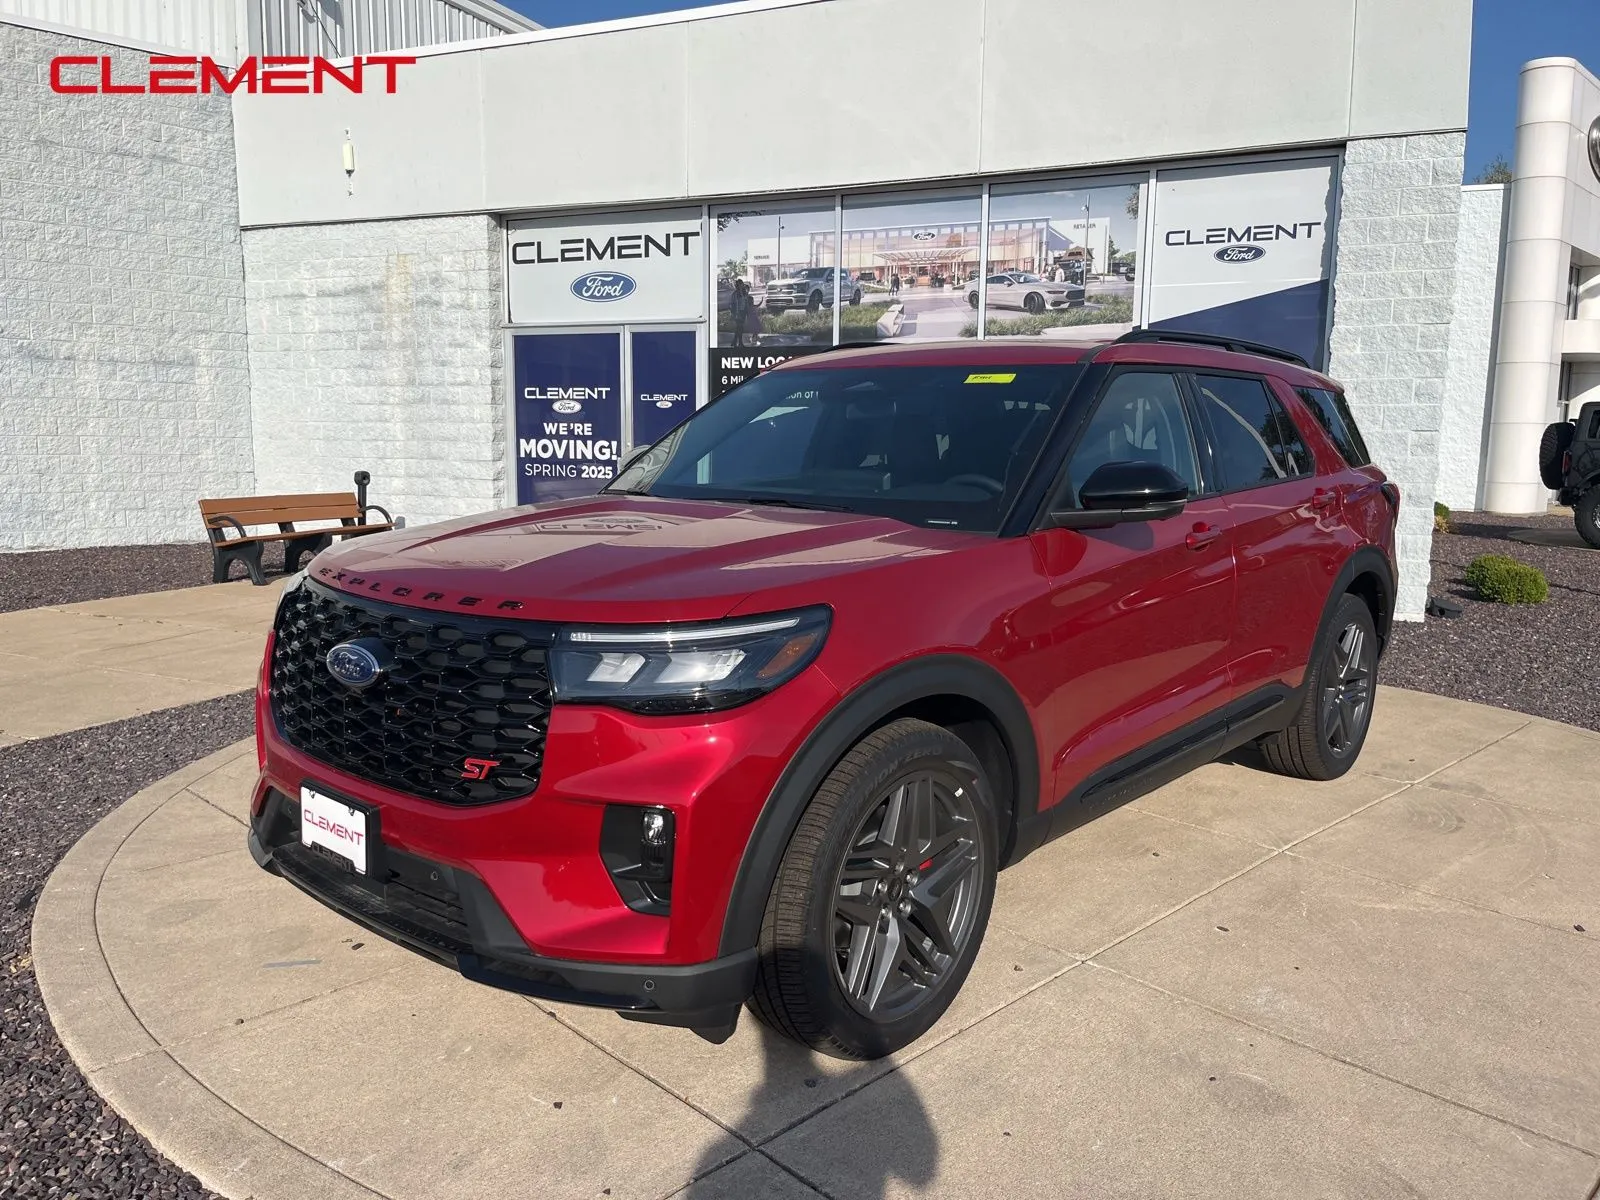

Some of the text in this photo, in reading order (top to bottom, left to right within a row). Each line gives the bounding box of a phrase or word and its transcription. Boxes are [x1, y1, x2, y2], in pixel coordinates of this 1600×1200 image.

[1165, 222, 1321, 247] CLEMENT
[512, 231, 701, 265] CLEMENT
[721, 356, 754, 369] NEW
[721, 375, 728, 385] 6
[524, 387, 610, 400] CLEMENT
[640, 393, 689, 401] CLEMENT
[543, 422, 593, 436] WE'RE
[519, 438, 618, 461] MOVING!
[524, 463, 613, 479] SPRING 2025
[318, 567, 525, 612] EXPLORER
[460, 757, 503, 780] ST
[303, 808, 365, 846] CLEMENT
